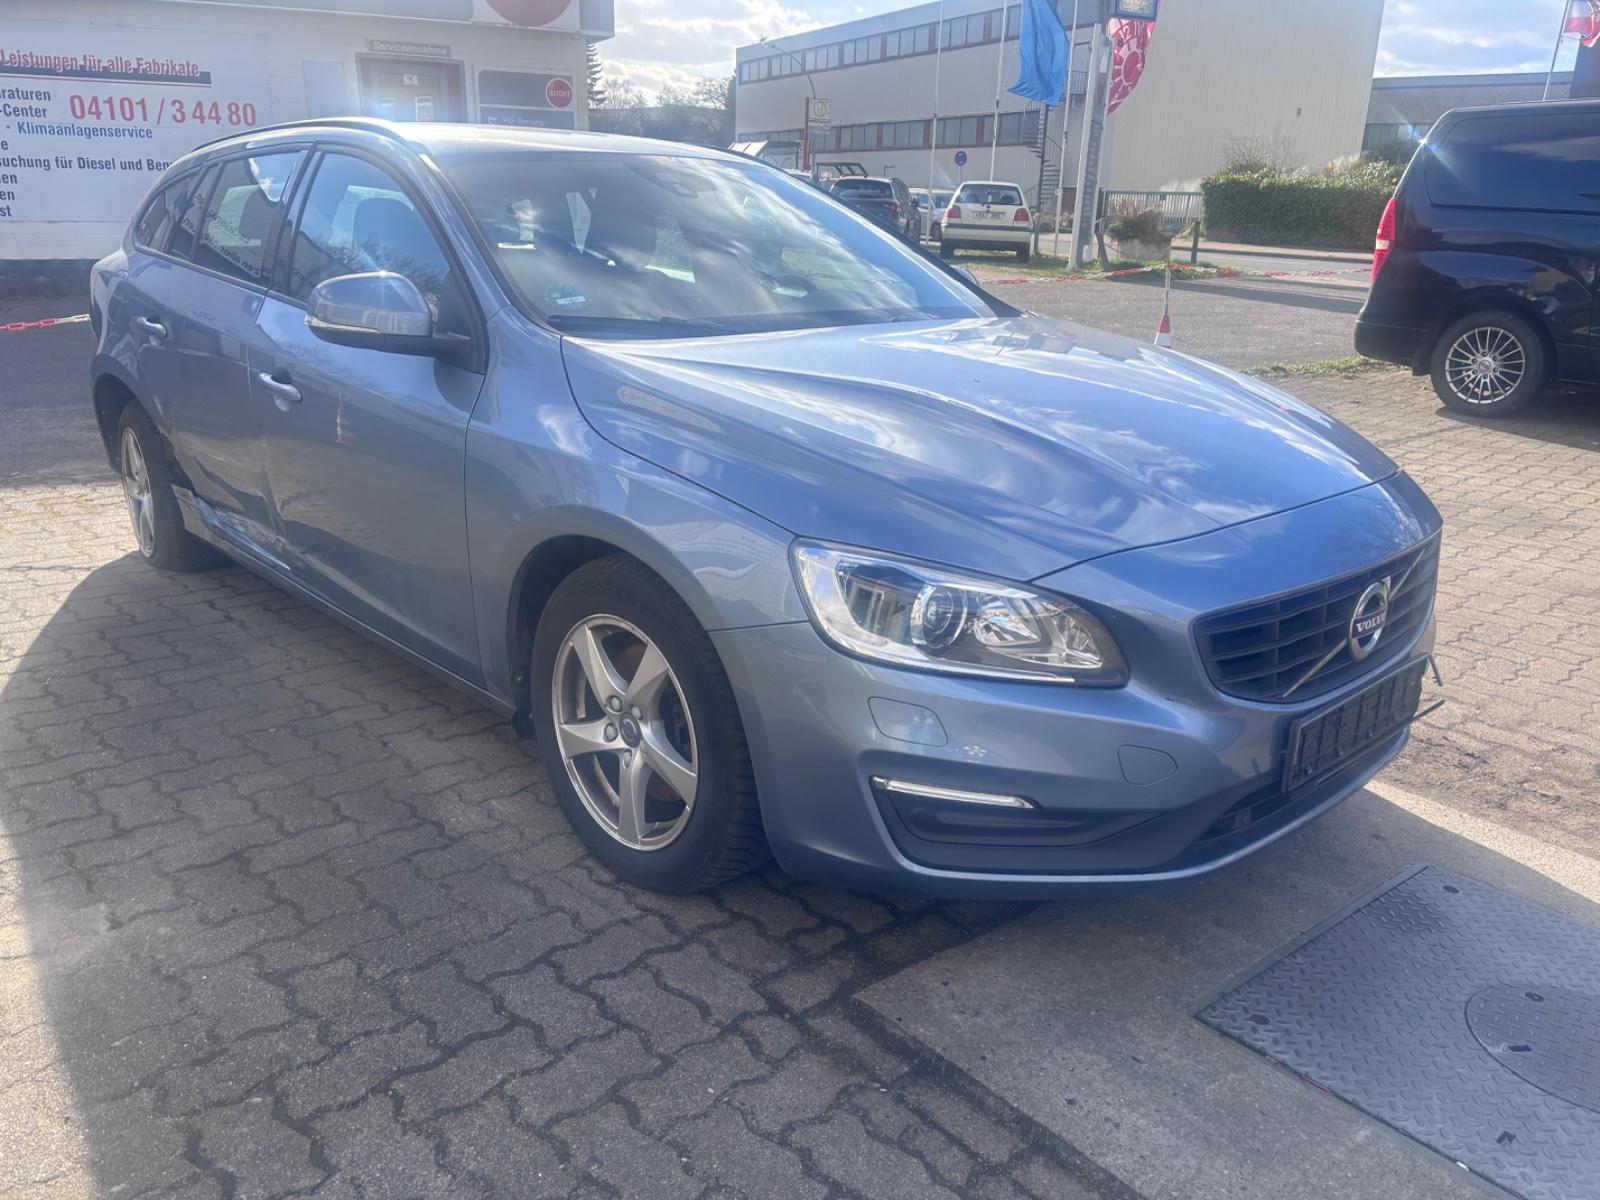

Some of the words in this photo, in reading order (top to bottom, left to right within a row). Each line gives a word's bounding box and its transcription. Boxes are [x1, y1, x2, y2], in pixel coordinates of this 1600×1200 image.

[0, 49, 81, 72] Leistungen
[82, 54, 103, 71] für
[107, 56, 132, 73] alle
[136, 57, 199, 75] Fabrikate
[0, 87, 51, 101] raturen
[69, 94, 148, 121] 04101
[171, 99, 186, 123] 3
[192, 100, 222, 125] 44
[227, 102, 256, 126] 80
[17, 122, 153, 139] Klimaanlagenservice
[0, 155, 51, 171] uchung
[54, 156, 73, 169] für
[77, 157, 116, 170] Diesel
[120, 159, 143, 170] und
[147, 159, 174, 171] Ben
